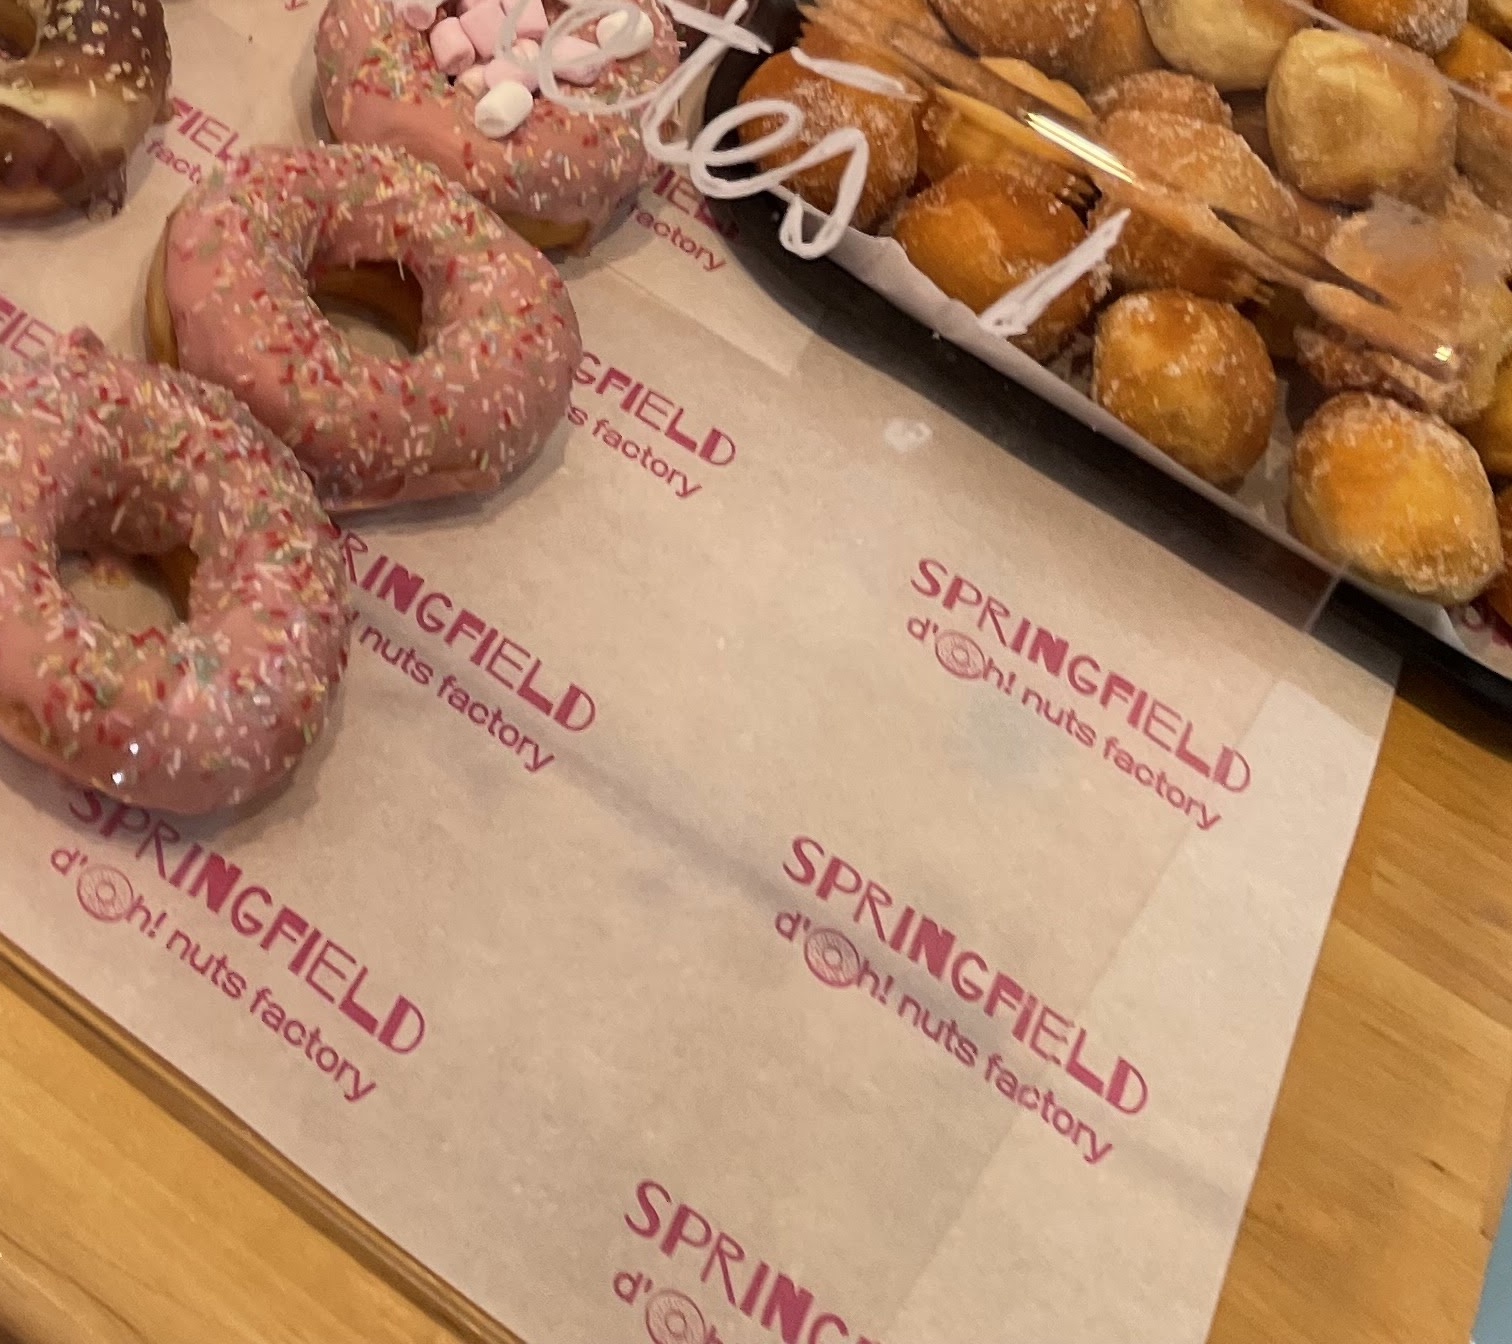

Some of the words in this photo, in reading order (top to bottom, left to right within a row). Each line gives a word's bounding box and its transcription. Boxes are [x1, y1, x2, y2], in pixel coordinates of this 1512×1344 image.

[634, 209, 727, 272] actory
[591, 417, 703, 499] factory
[338, 528, 597, 734] RINGFIELD
[358, 620, 436, 688] nuts
[437, 672, 556, 774] factory
[910, 556, 1253, 794] SPRINGFIELD
[1020, 679, 1098, 750] nuts
[1102, 733, 1223, 832] factory
[164, 921, 249, 1000] nuts
[248, 986, 378, 1104] factory
[782, 835, 1150, 1116] SPRINGFIELD
[896, 989, 980, 1068] nuts
[984, 1052, 1113, 1165] factory
